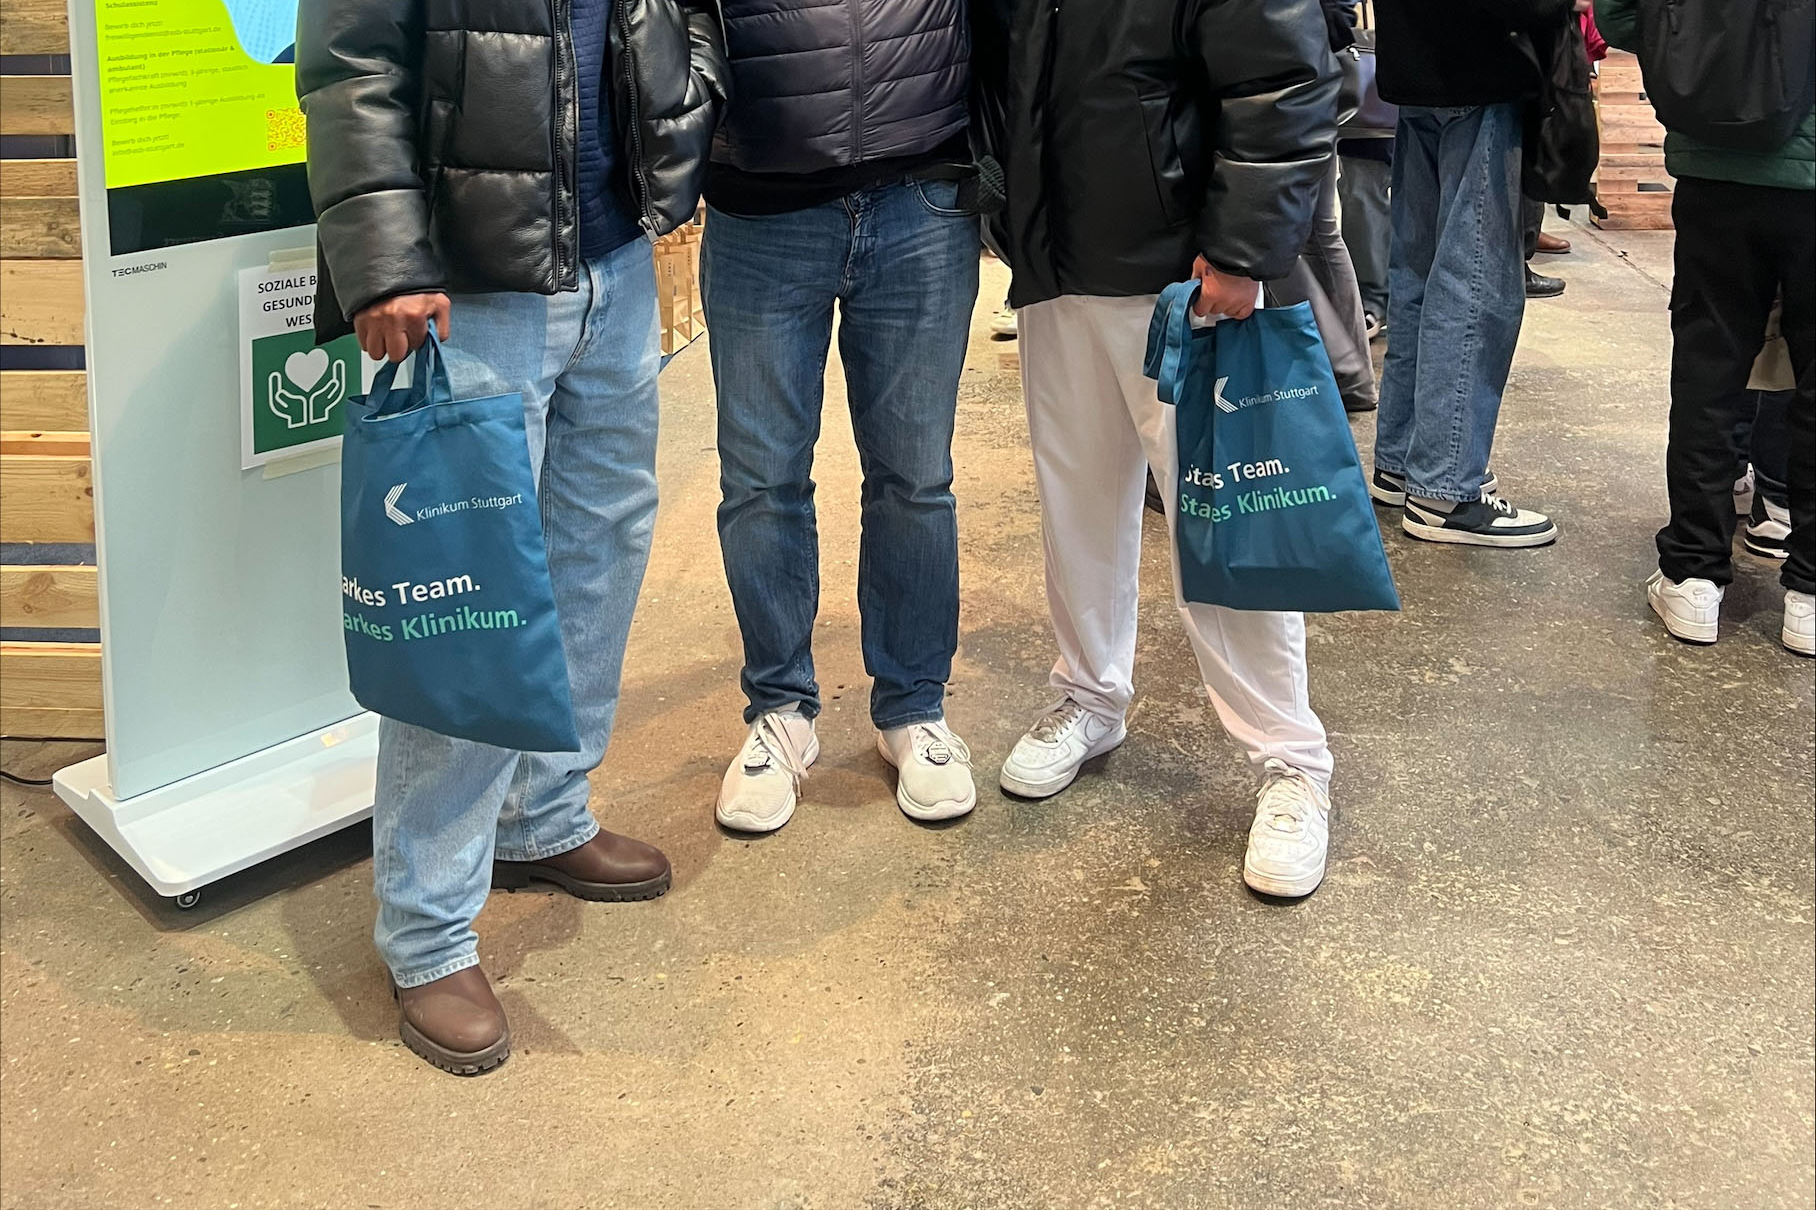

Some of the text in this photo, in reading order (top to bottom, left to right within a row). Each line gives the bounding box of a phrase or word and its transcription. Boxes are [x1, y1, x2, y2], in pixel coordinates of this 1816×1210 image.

[258, 275, 317, 294] SOZIALE B
[263, 295, 313, 312] GESUND
[285, 314, 312, 328] WES
[1273, 385, 1319, 401] Stuttgart
[1227, 458, 1290, 483] Team.
[416, 493, 522, 521] Klinikum Stuttgart
[1236, 484, 1337, 515] Klinikum.
[342, 573, 481, 607] arkes Team.
[343, 605, 527, 641] arkes Klinikum.
